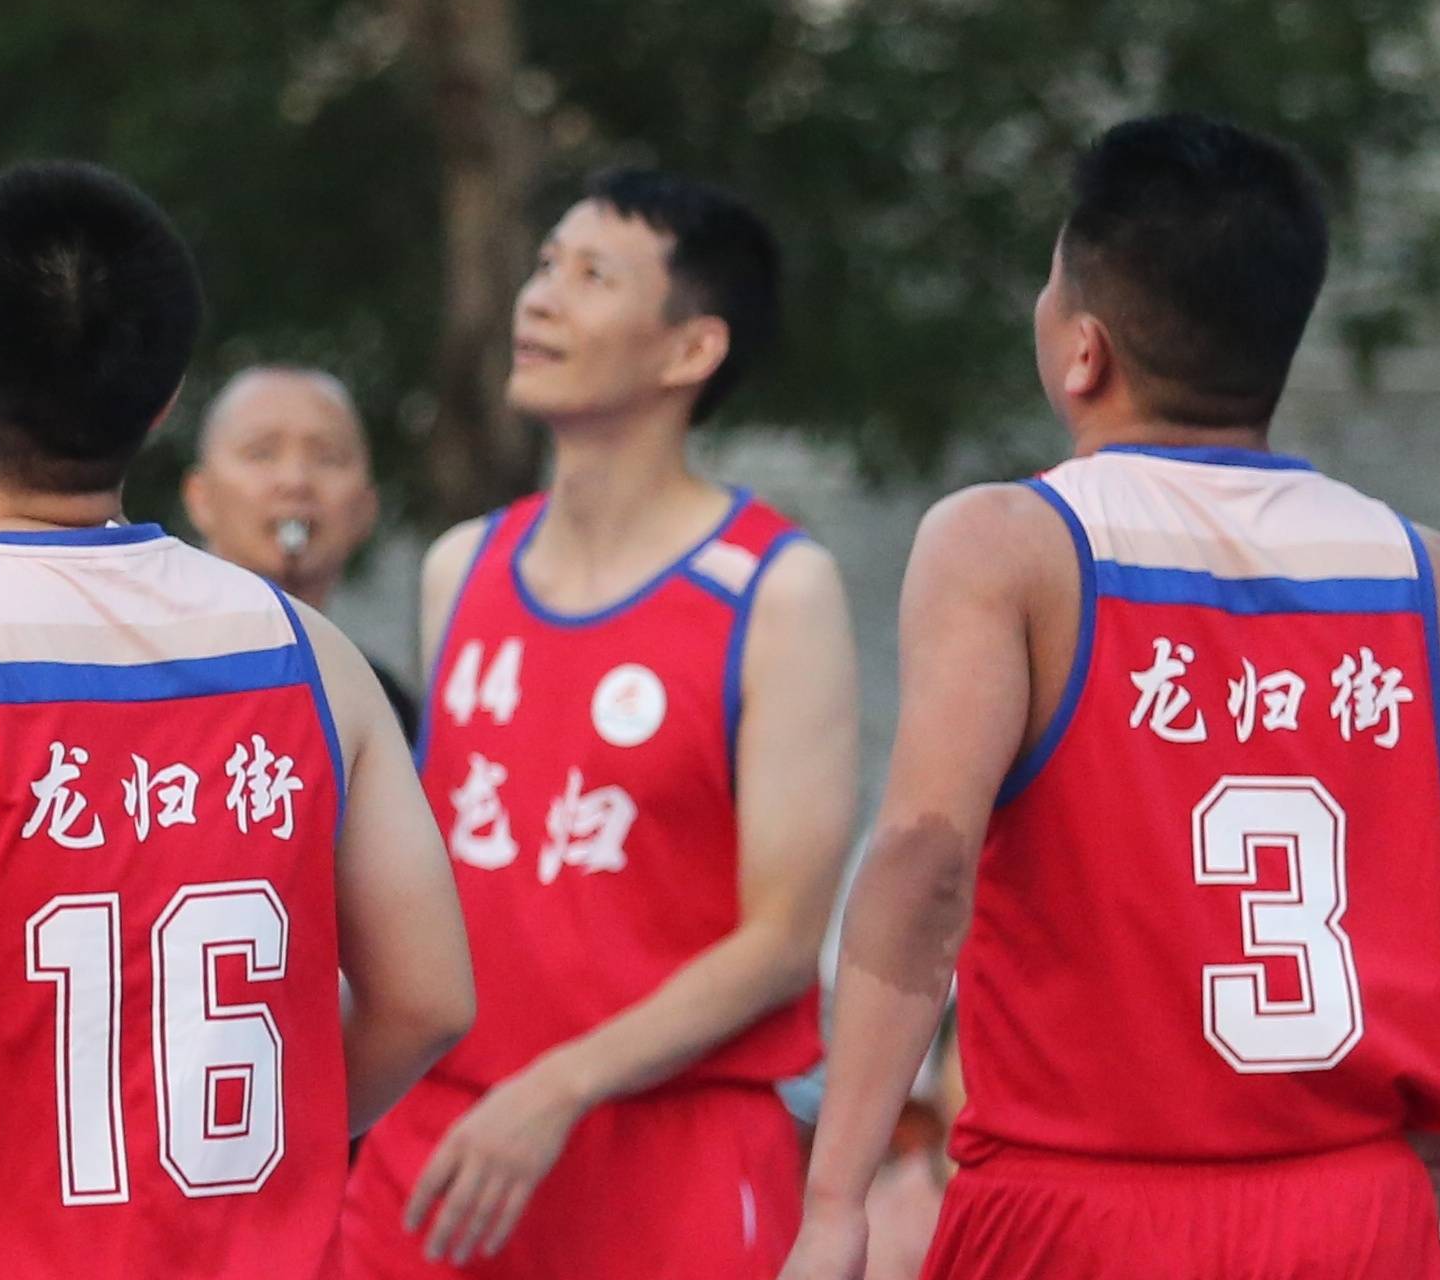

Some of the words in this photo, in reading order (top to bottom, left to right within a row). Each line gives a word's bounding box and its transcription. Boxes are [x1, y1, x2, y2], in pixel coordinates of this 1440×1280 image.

[444, 638, 523, 727] 44
[1129, 636, 1414, 749] 龙归街
[21, 734, 304, 851] 龙归街
[448, 754, 638, 885] 龙归
[1191, 774, 1364, 1073] 3
[25, 878, 289, 1207] 16
